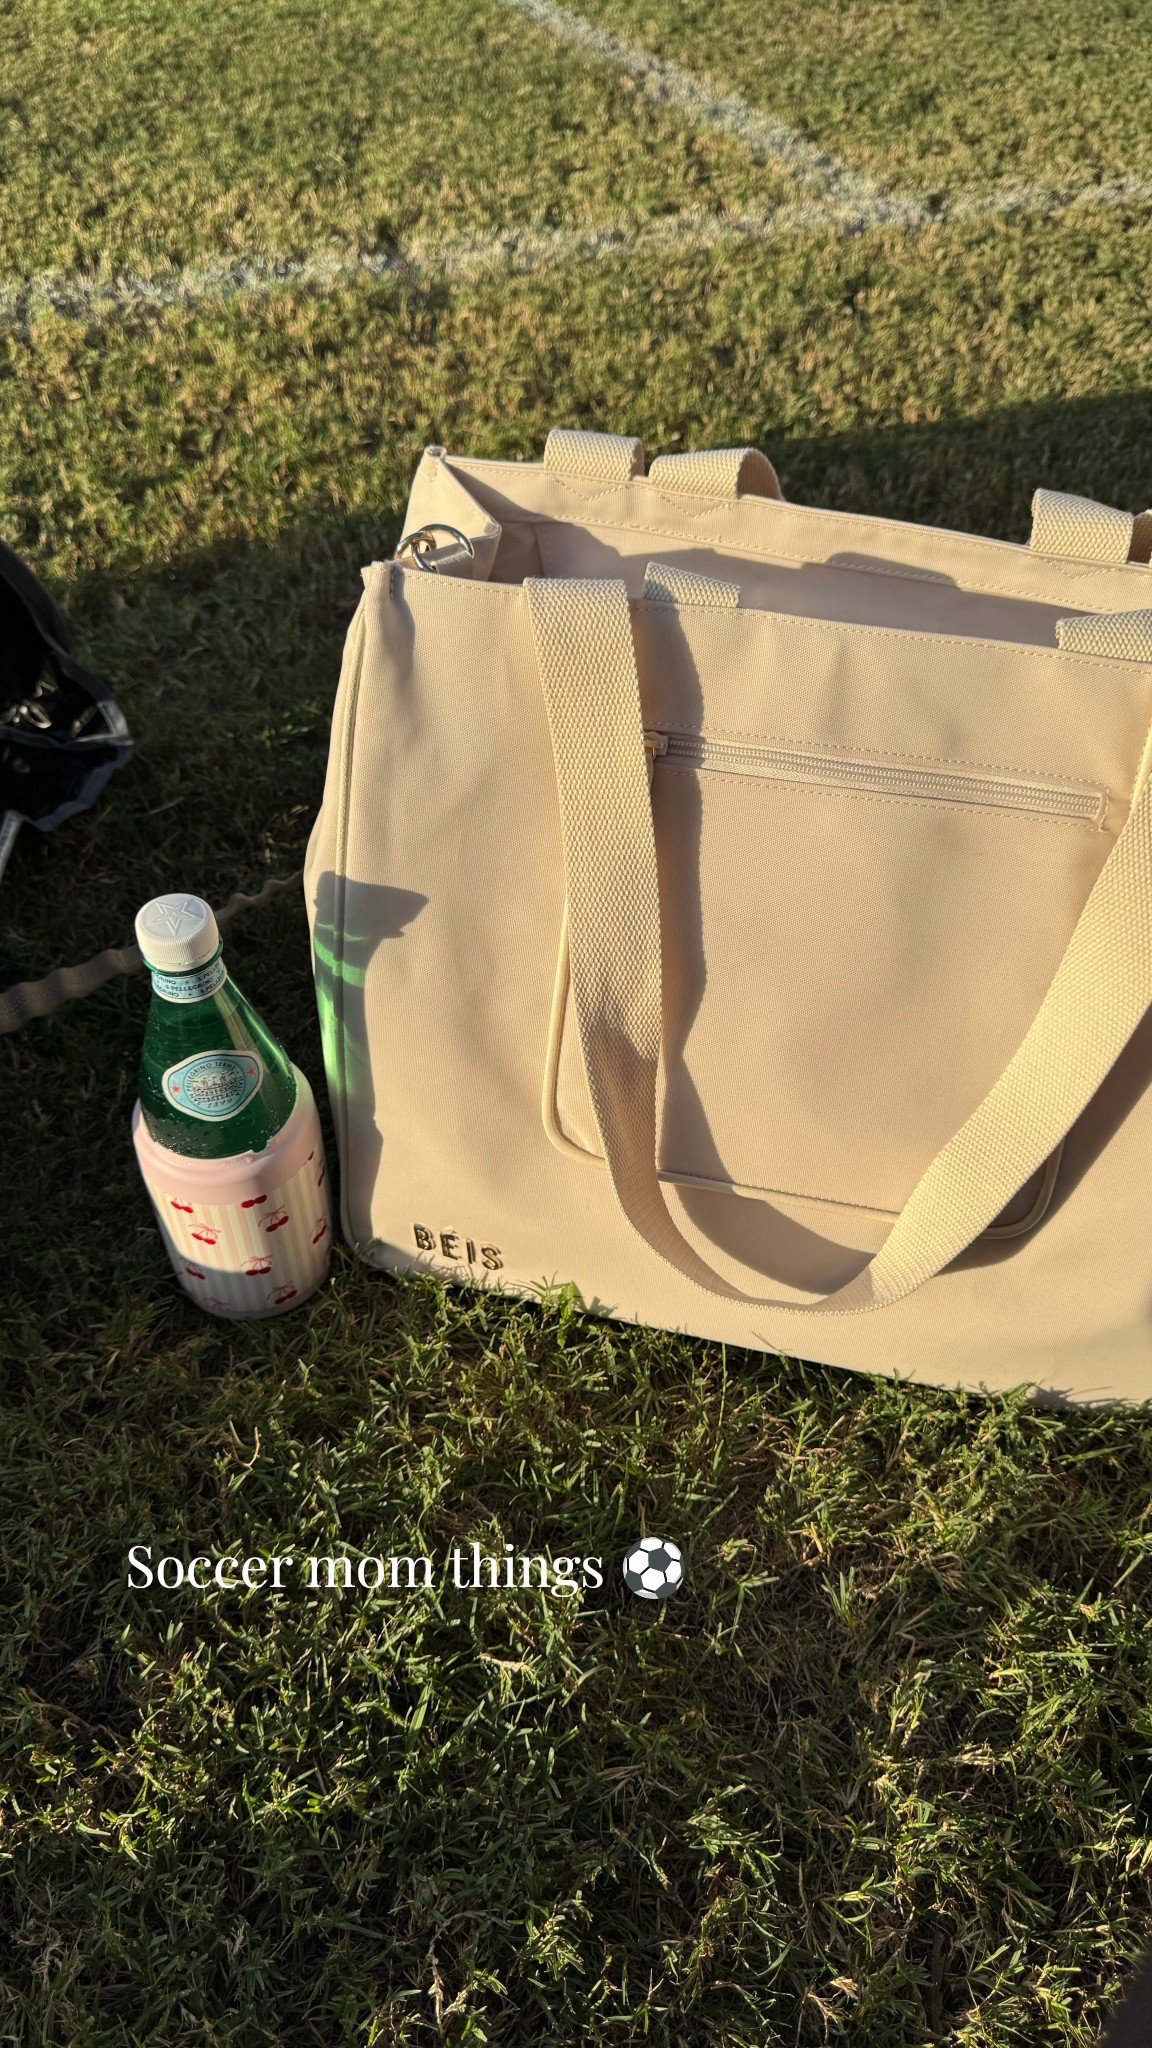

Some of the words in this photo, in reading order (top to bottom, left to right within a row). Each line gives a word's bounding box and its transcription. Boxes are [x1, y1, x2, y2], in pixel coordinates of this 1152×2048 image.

[215, 1061, 236, 1070] TERME
[186, 1062, 212, 1092] PELLEGRINO
[234, 1075, 244, 1096] ITALIA
[188, 1093, 203, 1106] SAN
[207, 1098, 233, 1109] 1899
